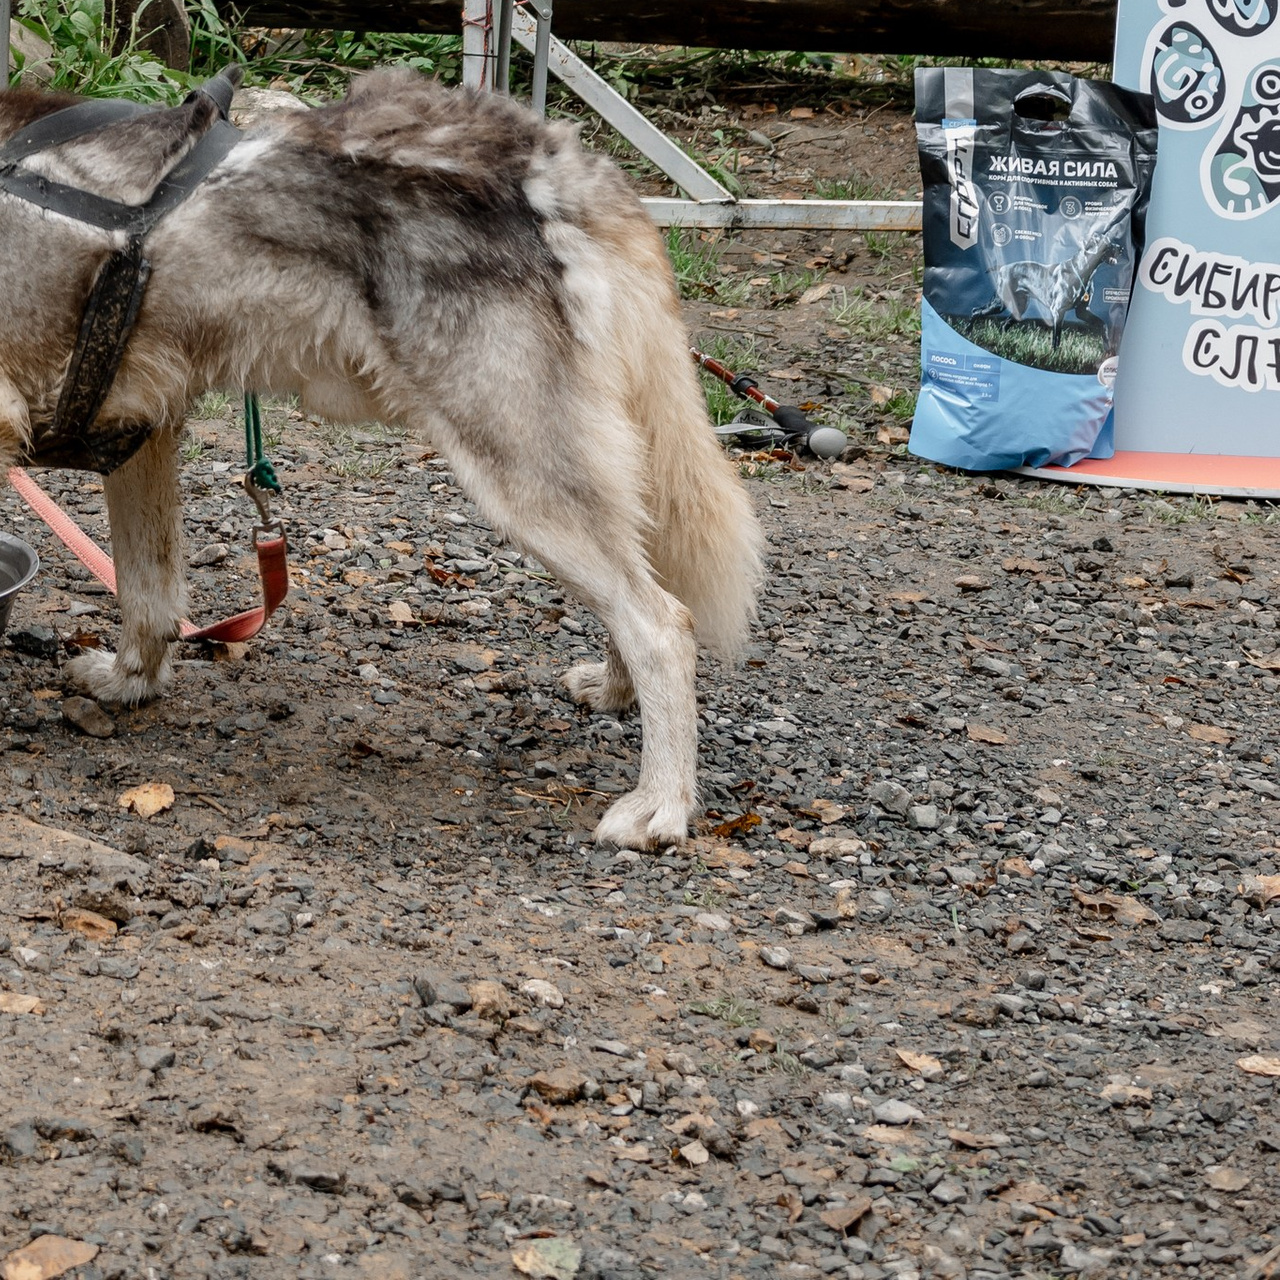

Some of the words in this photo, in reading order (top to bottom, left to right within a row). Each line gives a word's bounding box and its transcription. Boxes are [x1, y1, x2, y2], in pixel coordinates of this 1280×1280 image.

[989, 155, 1059, 178] ЖИВАЯ
[1064, 162, 1118, 178] СИЛА
[1021, 176, 1058, 186] СПОРТИВНЫХ
[1149, 247, 1280, 320] СИБИР
[931, 355, 957, 365] ЛОСОСЬ
